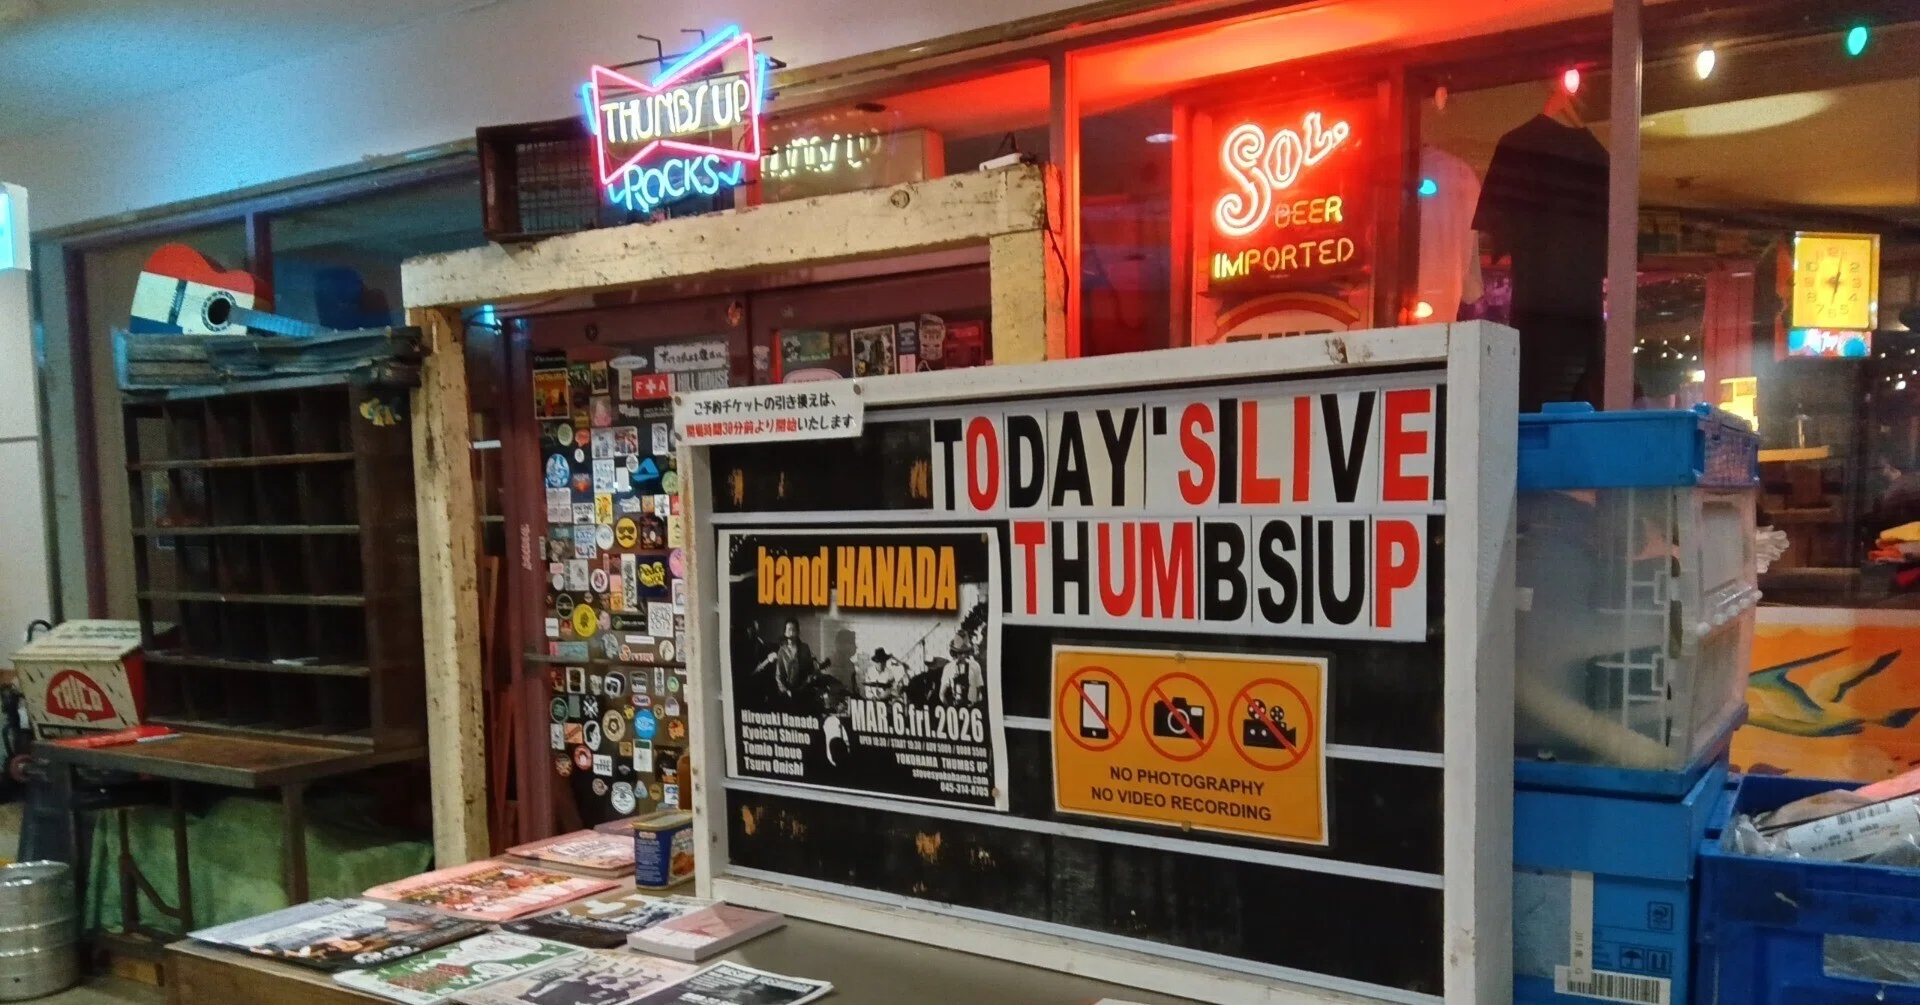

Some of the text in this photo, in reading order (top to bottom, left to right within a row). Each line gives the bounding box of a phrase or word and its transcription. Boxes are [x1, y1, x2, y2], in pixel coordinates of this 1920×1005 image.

[600, 79, 750, 143] THUMBS UP
[623, 154, 720, 213] ROCKS
[1274, 195, 1343, 228] BEER
[1213, 237, 1355, 279] IMPORTED
[934, 388, 1431, 511] TODAY'S LIVE
[757, 545, 958, 611] band HANADA
[1014, 519, 1421, 628] THUMBS UP
[741, 709, 820, 730] Hiroyuki Hanada
[742, 724, 779, 741] Kyoichi
[743, 740, 803, 761] Tomio Inoue
[744, 756, 804, 777] Tsuru Onishi
[895, 752, 988, 774] YOKOHAMA THUMBS UP
[1110, 766, 1265, 797] NO PHOTOGRAPHY
[1091, 786, 1272, 822] NO VIDEO RECORDING
